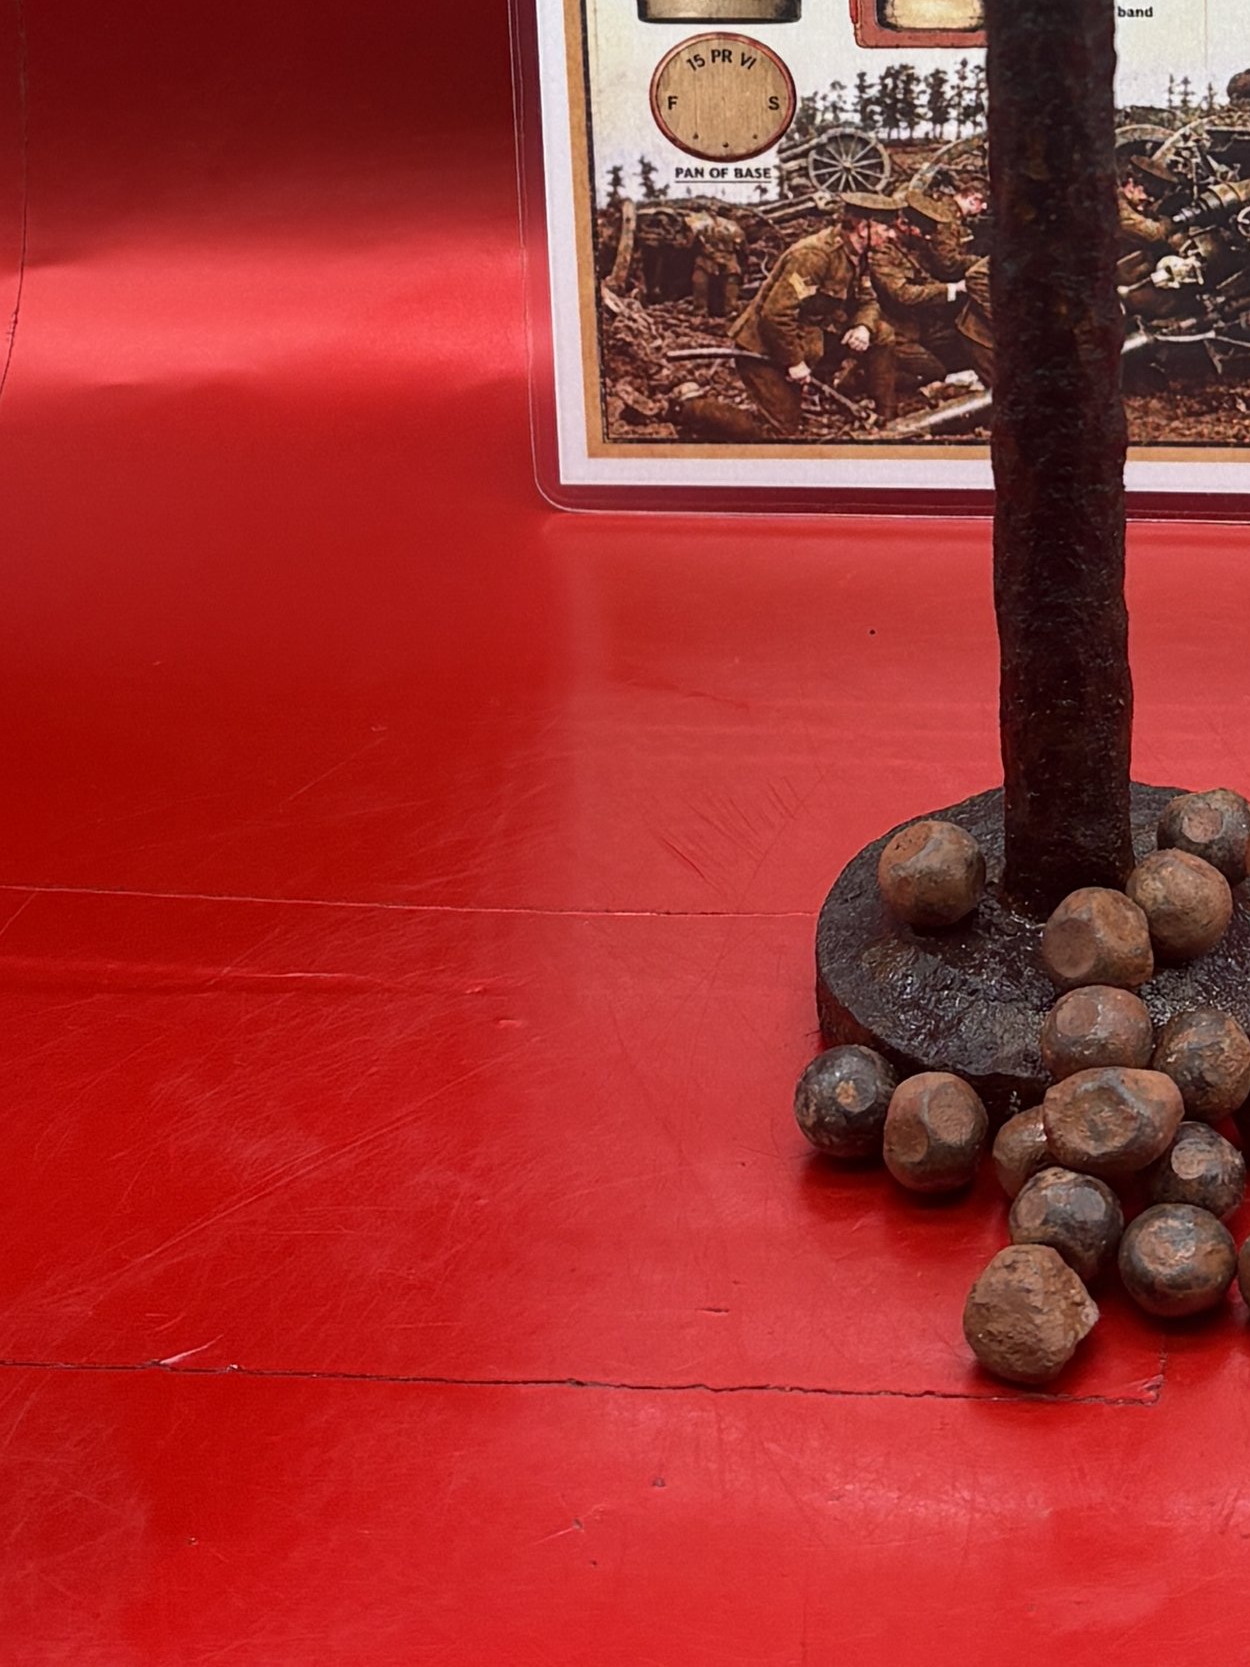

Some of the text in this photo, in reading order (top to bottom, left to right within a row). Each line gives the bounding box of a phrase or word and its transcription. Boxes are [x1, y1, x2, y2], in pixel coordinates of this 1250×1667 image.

[686, 49, 757, 71] 15 PR VI
[667, 96, 678, 110] F
[768, 96, 780, 110] S
[675, 167, 771, 178] PAN OF BASE
